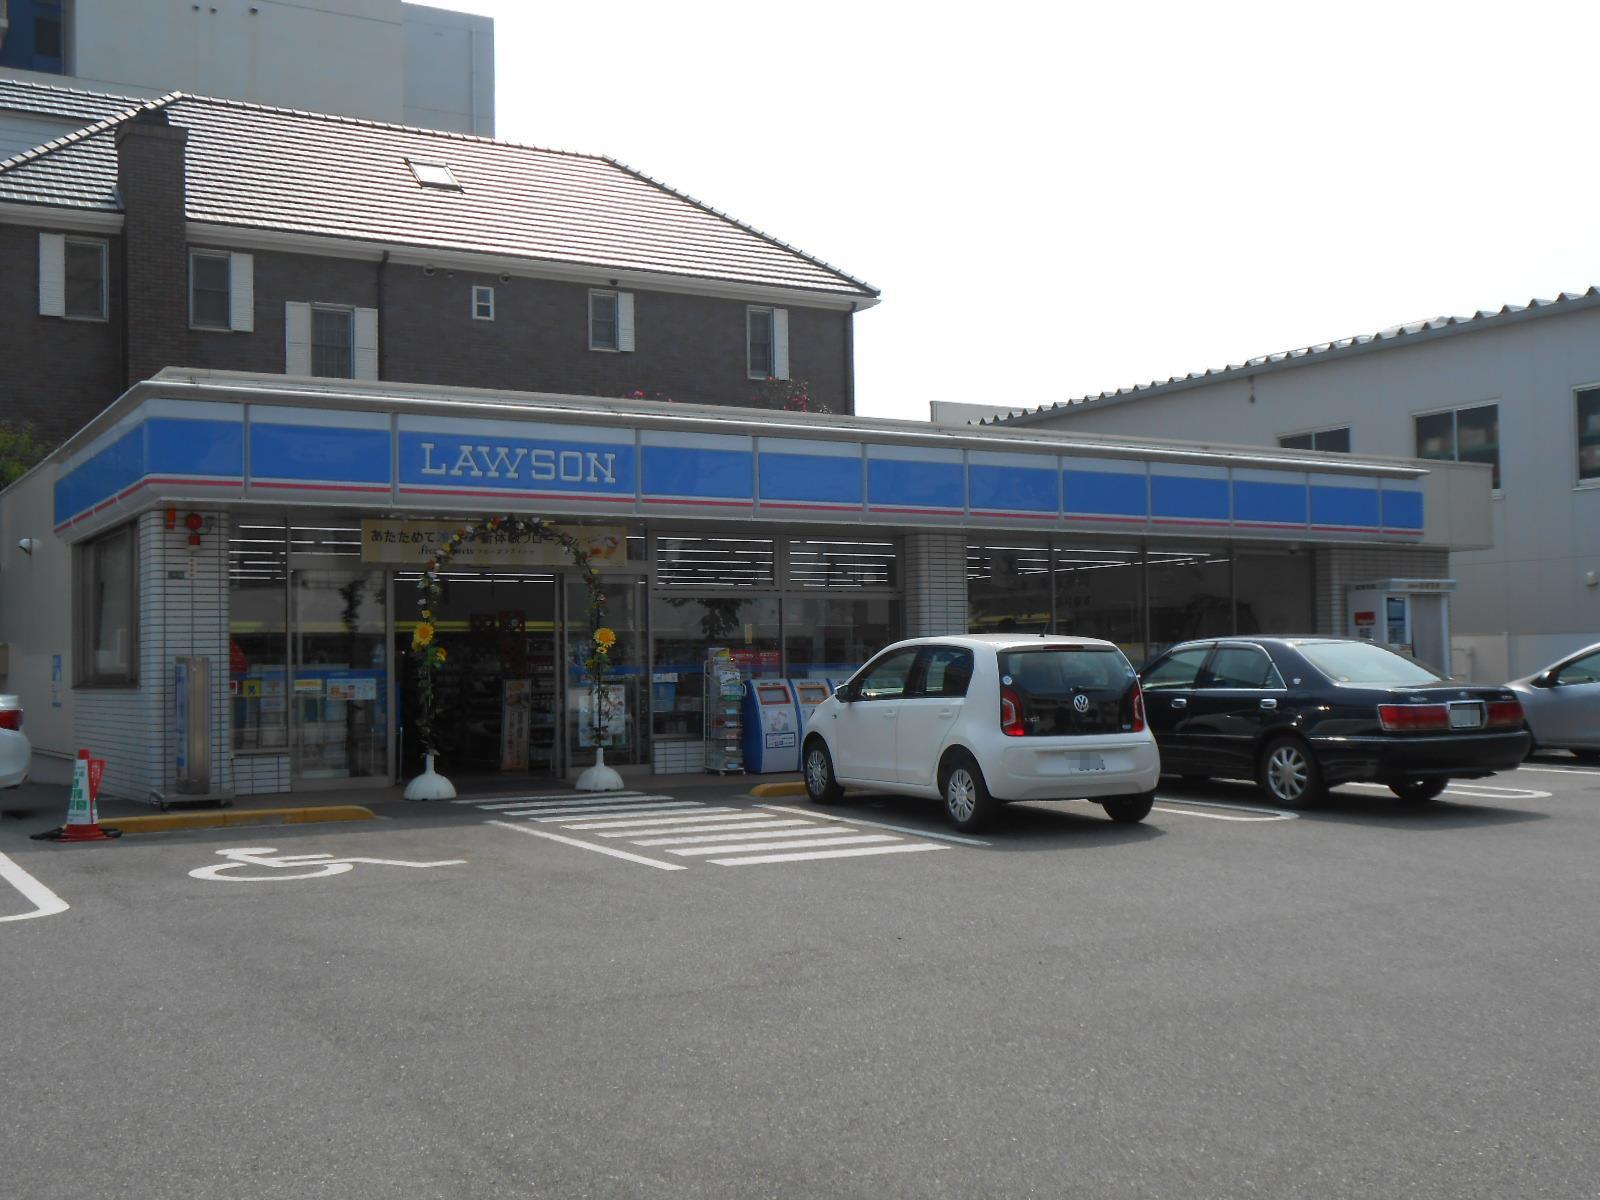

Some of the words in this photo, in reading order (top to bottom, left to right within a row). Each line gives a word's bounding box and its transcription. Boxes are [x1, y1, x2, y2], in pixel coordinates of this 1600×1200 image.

[420, 441, 616, 484] LAWSON
[370, 529, 436, 544] あたためて
